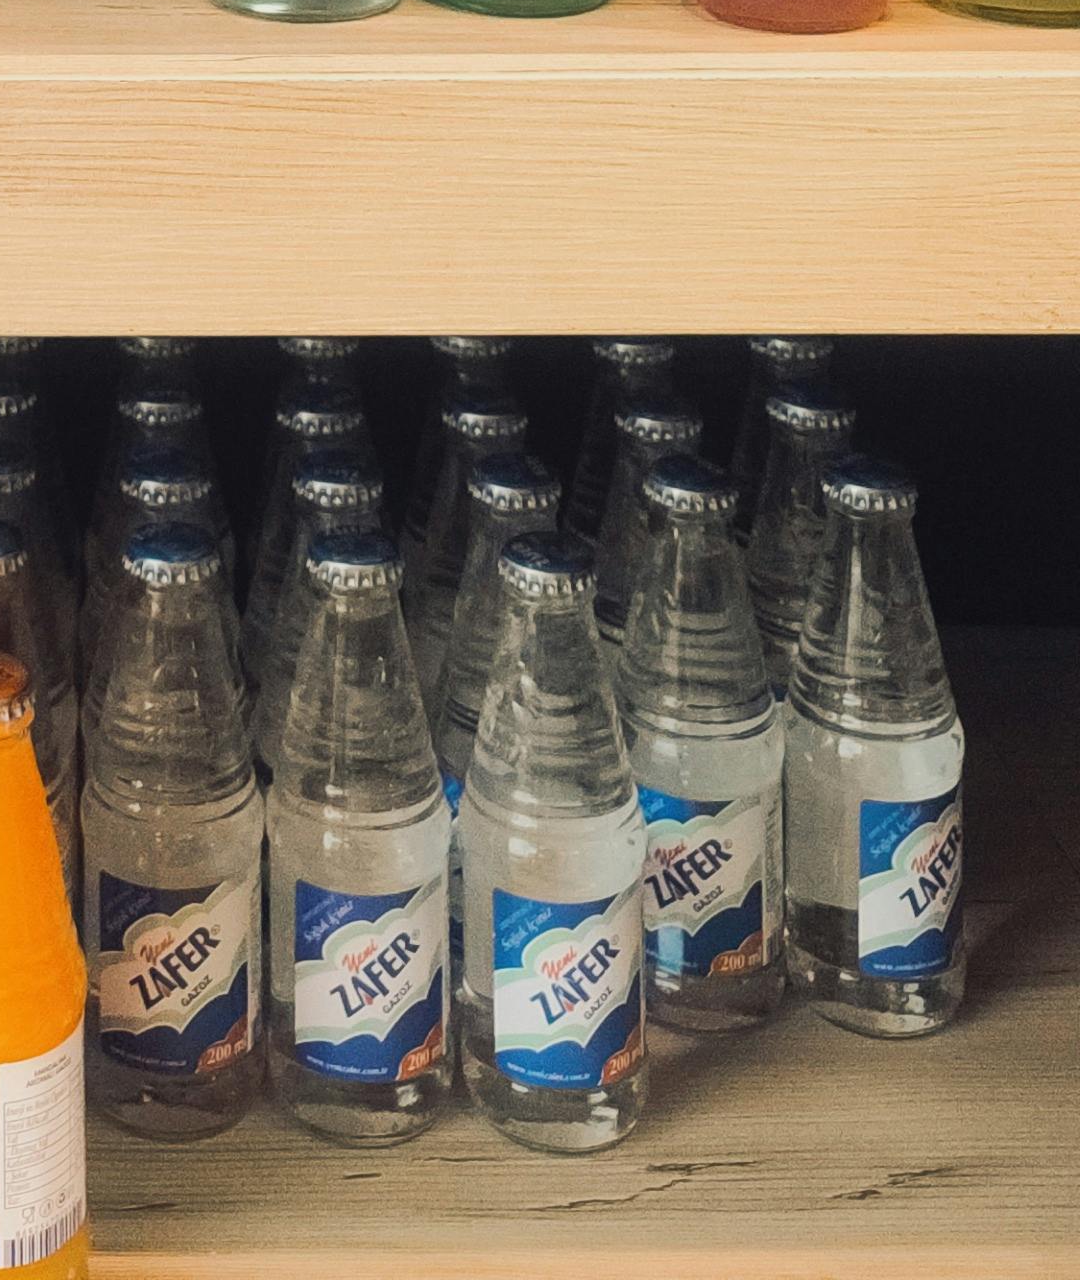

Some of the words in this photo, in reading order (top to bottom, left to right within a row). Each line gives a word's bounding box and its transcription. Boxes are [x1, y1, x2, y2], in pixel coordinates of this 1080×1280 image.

[643, 838, 734, 910] ZAFER
[692, 885, 724, 914] GAZOZ
[128, 926, 222, 1011] ZAFER
[328, 931, 420, 1019] ZAFER
[720, 952, 745, 972] 200
[181, 974, 214, 1008] GAZOZ
[382, 980, 413, 1015] GAZOZ
[528, 937, 621, 1026] ZAFER
[583, 986, 613, 1021] GAZOZ
[206, 1046, 231, 1065] 200
[406, 1048, 430, 1072] 200
[608, 1052, 631, 1076] 200
